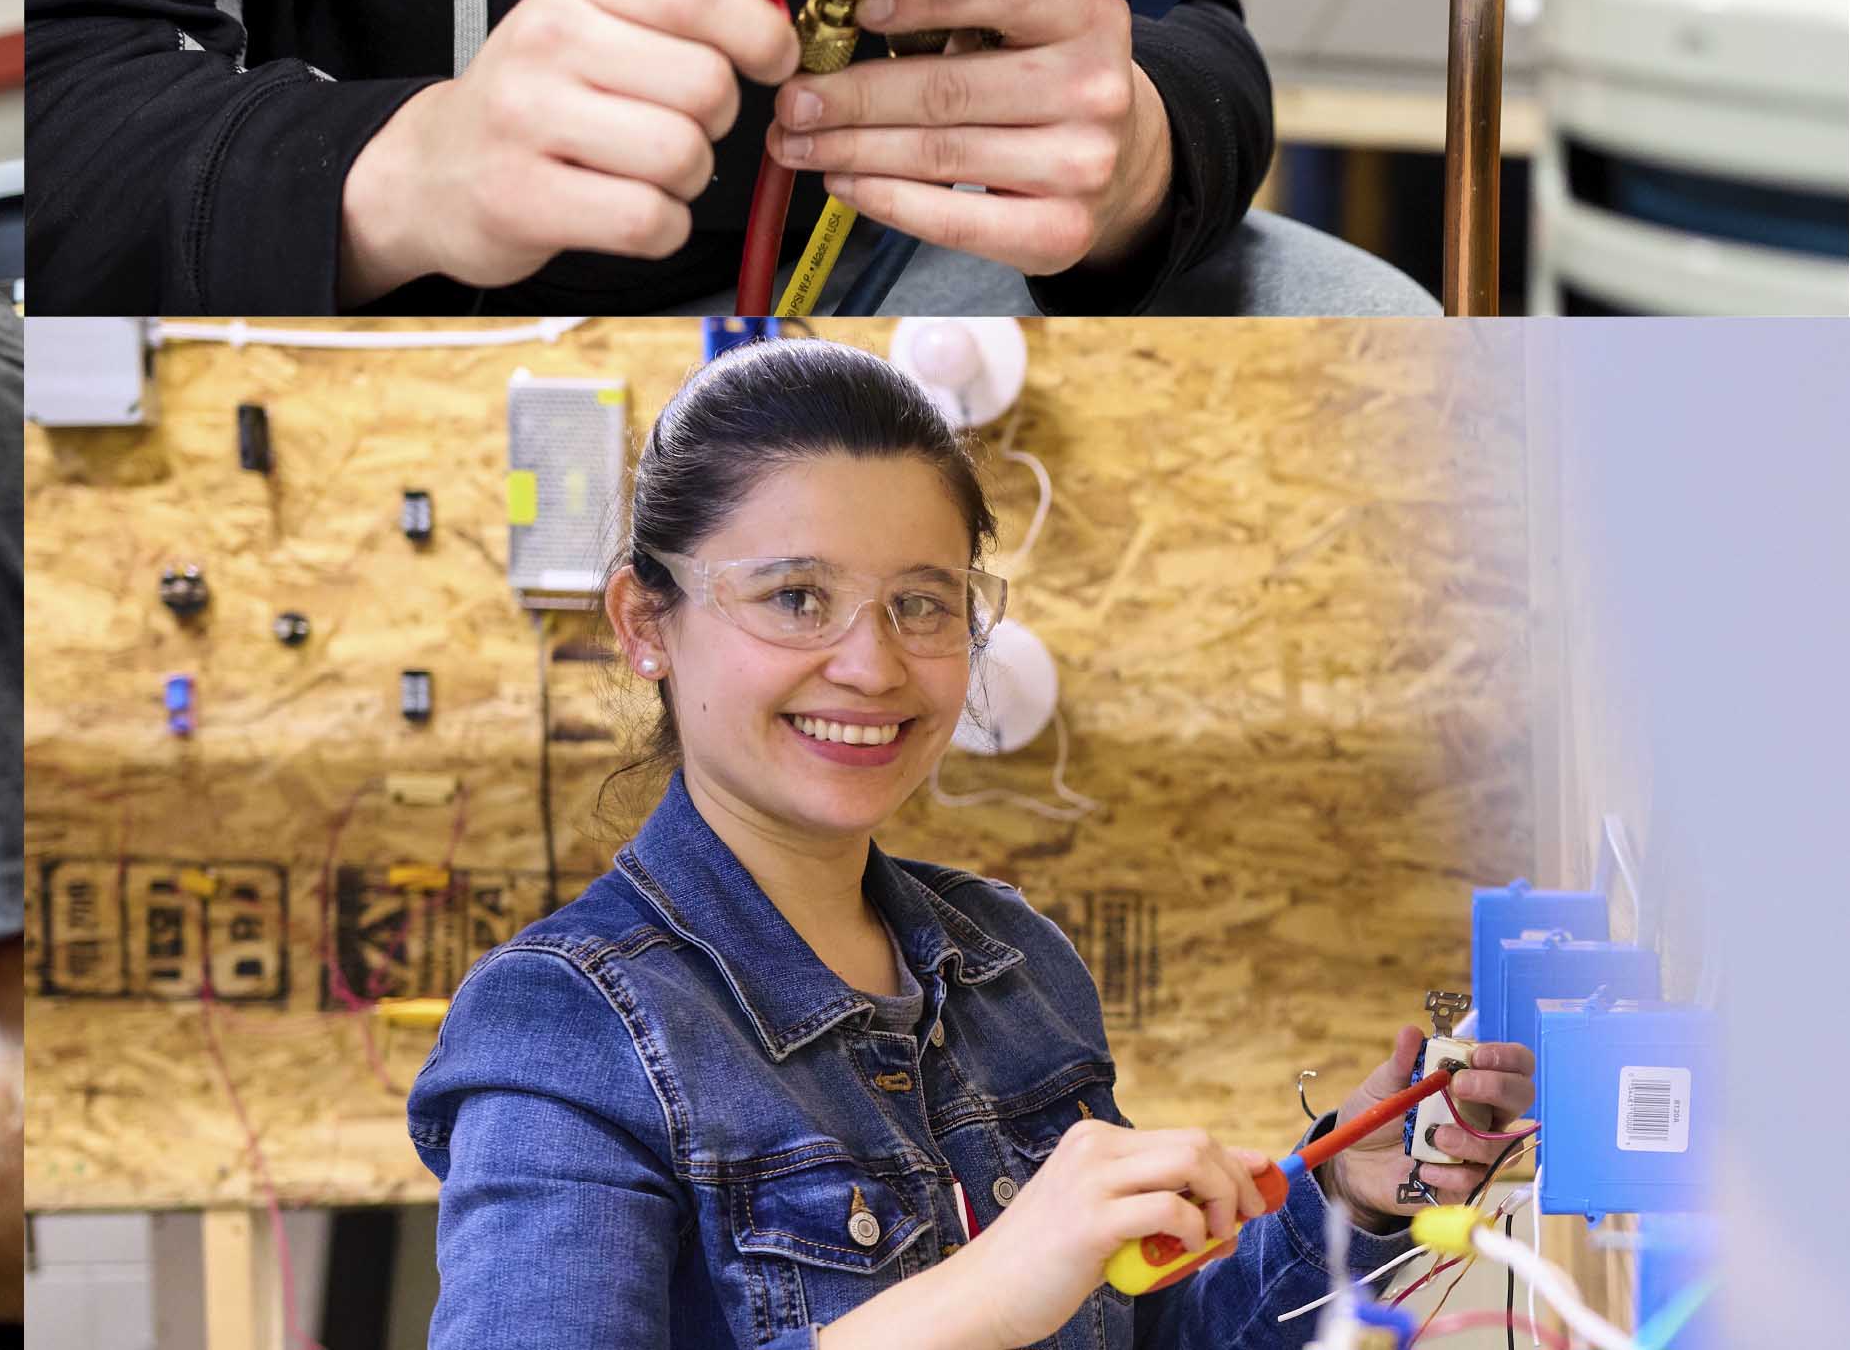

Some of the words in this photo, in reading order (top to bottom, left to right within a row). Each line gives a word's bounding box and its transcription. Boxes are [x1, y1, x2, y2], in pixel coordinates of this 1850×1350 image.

[790, 292, 805, 310] PSI
[811, 243, 828, 266] Made
[823, 233, 831, 243] in
[828, 212, 842, 233] USA
